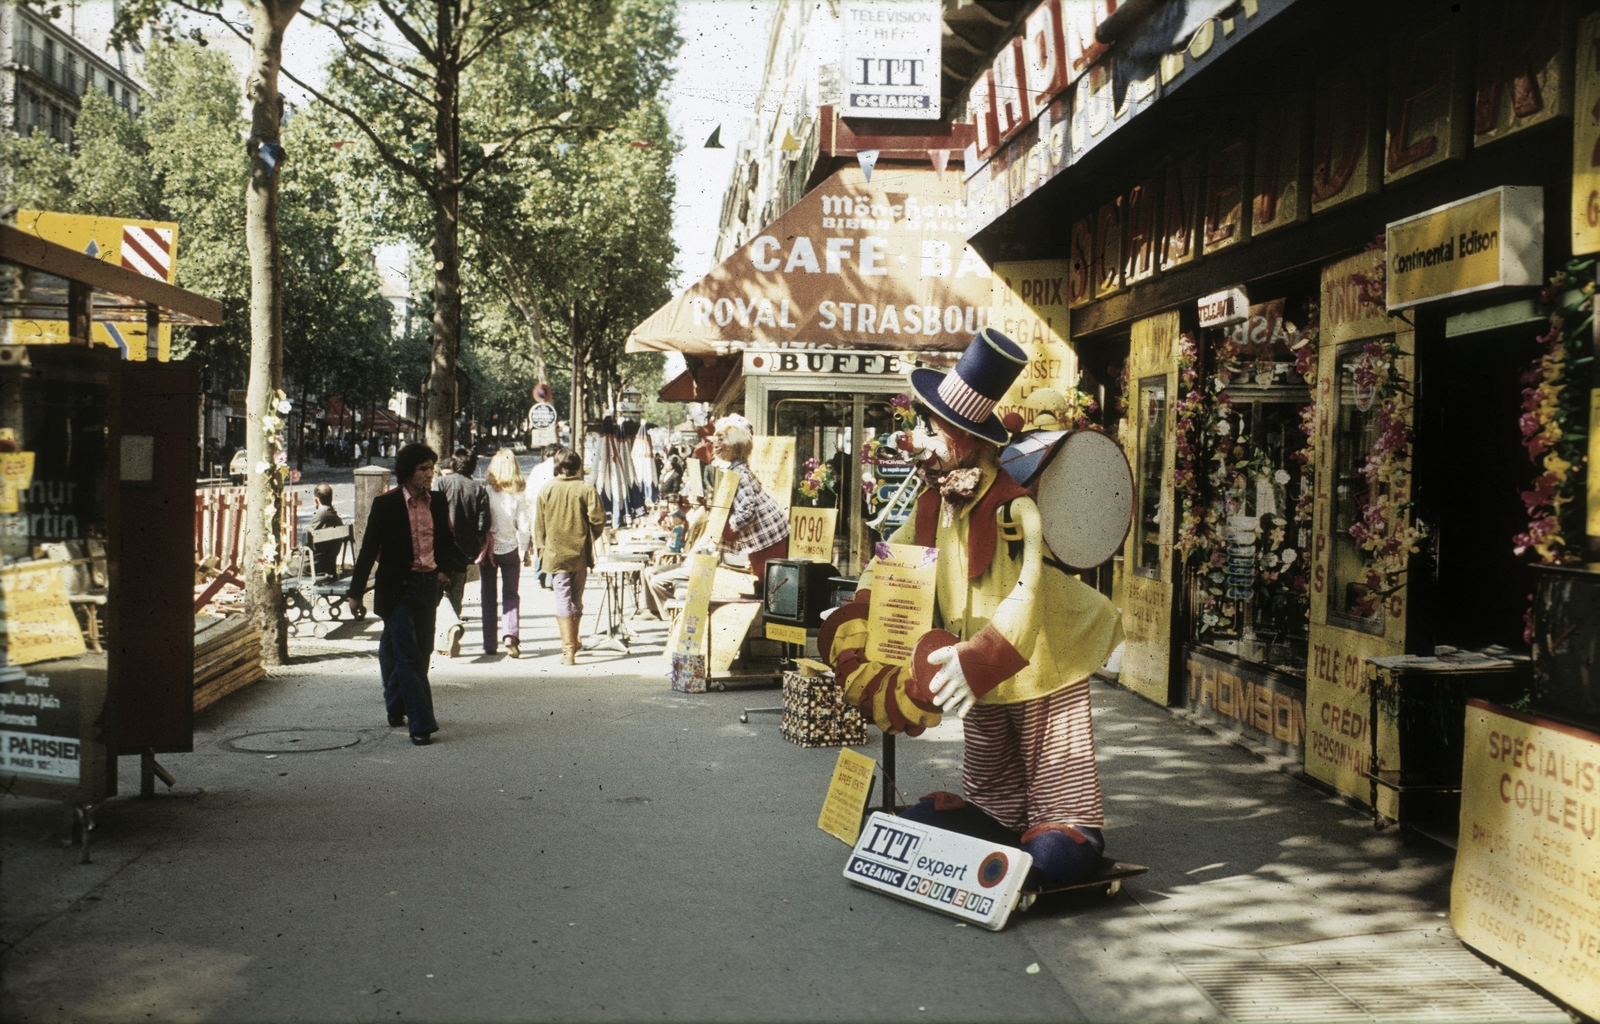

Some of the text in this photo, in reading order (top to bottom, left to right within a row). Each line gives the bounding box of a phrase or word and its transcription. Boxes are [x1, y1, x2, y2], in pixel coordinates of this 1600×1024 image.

[856, 57, 924, 86] ITT
[920, 239, 993, 279] BA
[1392, 230, 1498, 274] Continental Edison
[1021, 278, 1063, 305] PRIX
[693, 297, 796, 329] ROYAL
[794, 515, 823, 543] 1090
[862, 824, 921, 864] ITT
[917, 856, 968, 881] expert
[906, 875, 993, 916] COULEUR
[1465, 873, 1521, 917] SERVICE
